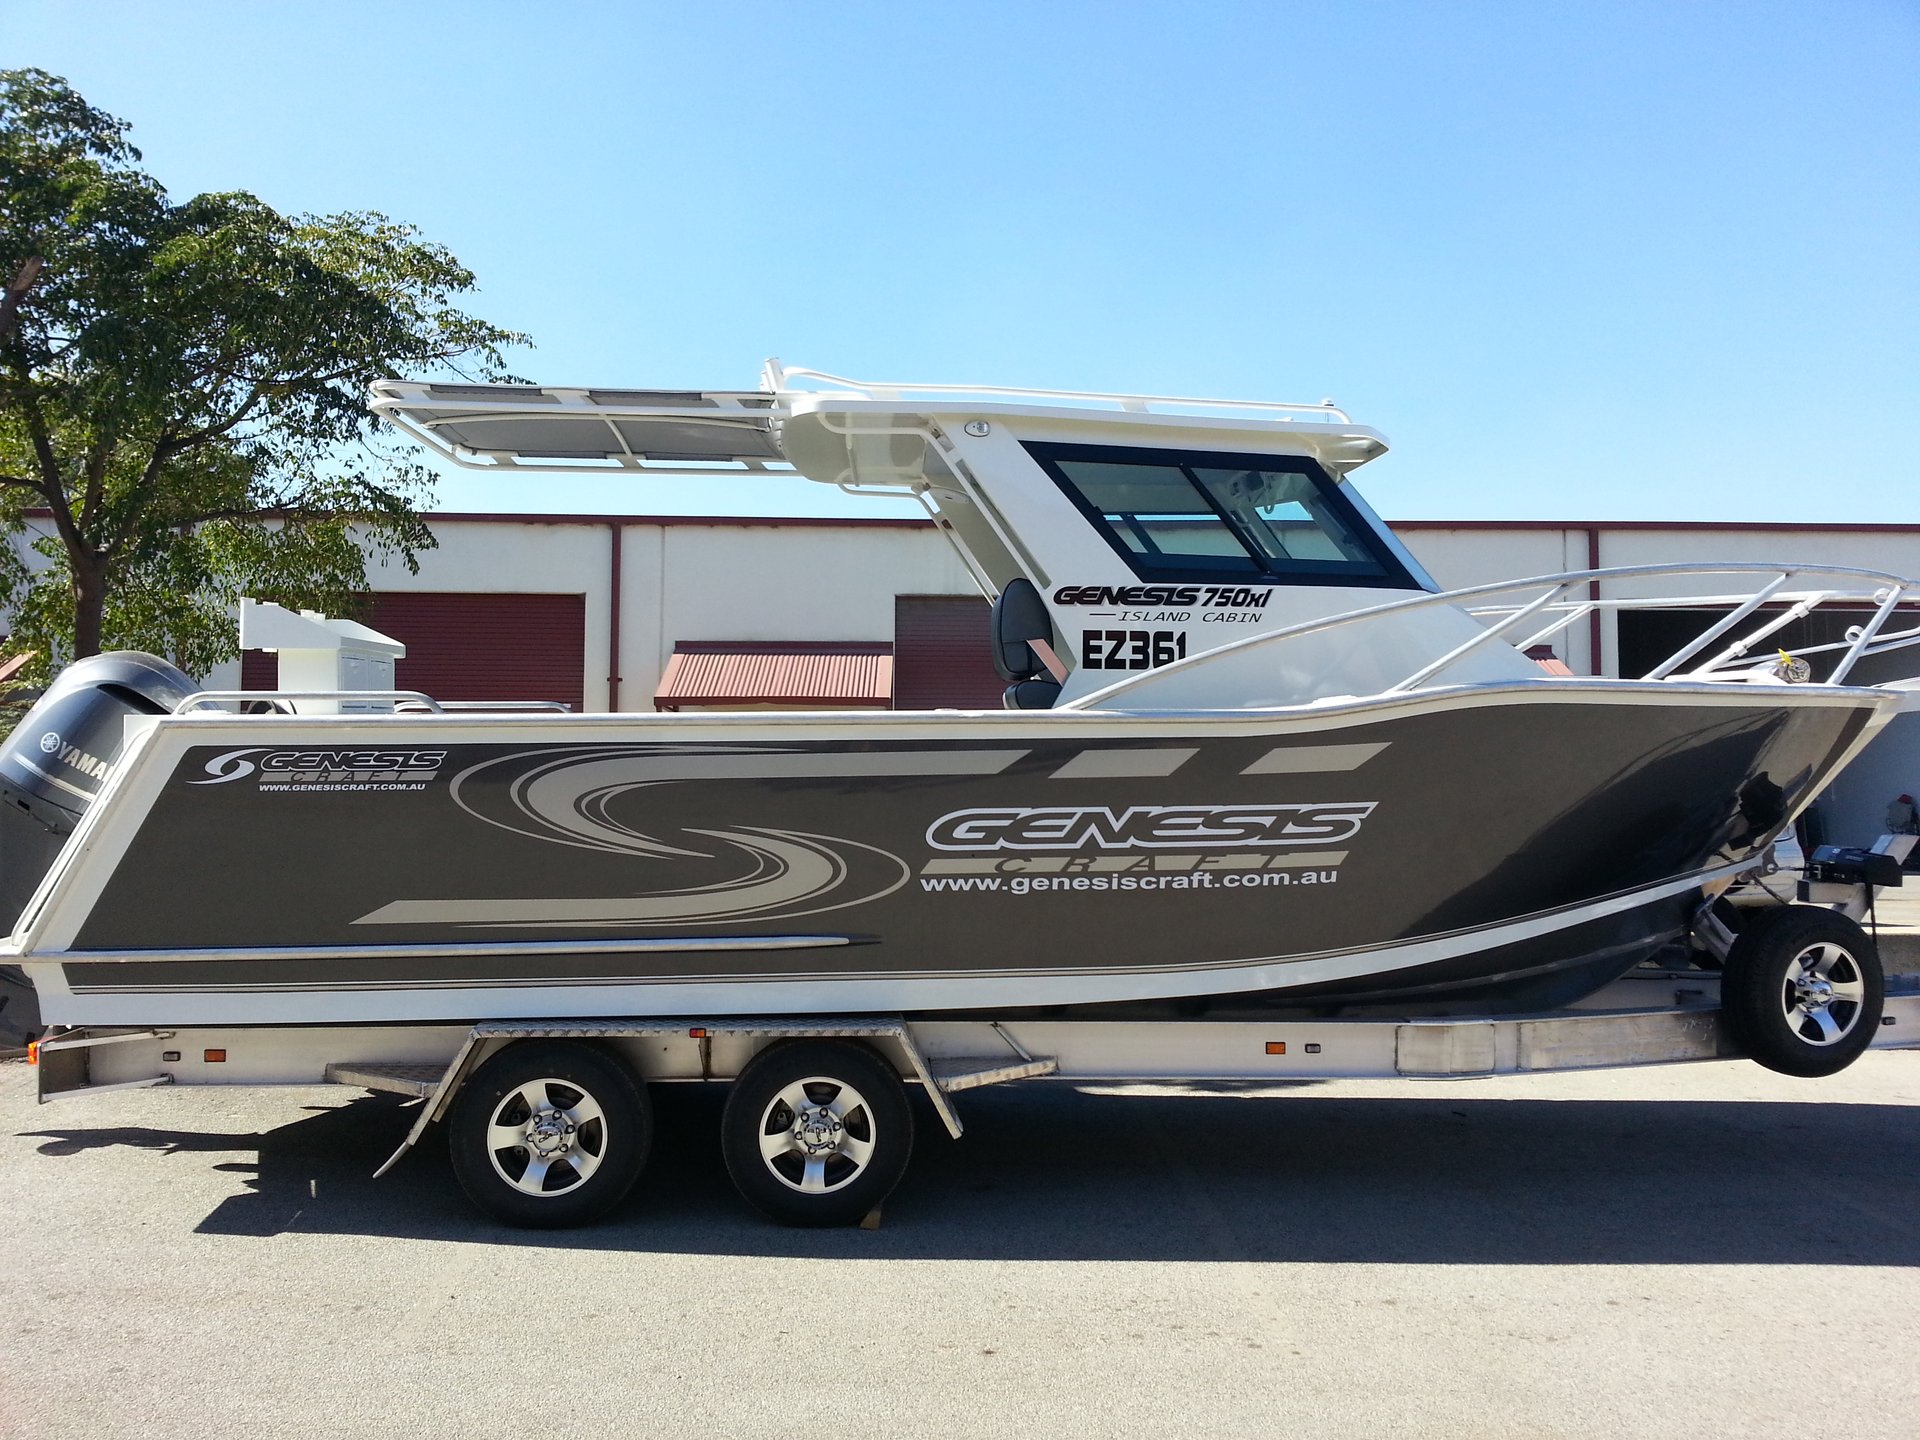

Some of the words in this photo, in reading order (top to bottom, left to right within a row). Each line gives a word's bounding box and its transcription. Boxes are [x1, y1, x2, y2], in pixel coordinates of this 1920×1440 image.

[1053, 585, 1201, 606] GENESIS
[1118, 611, 1191, 622] ISLAND
[1202, 612, 1263, 623] CABIN
[1082, 630, 1186, 669] EZ361
[57, 741, 112, 781] YAMA
[260, 751, 448, 771] GENESIS
[259, 783, 426, 791] WWW.GENESISCRAFT.COM.AU
[290, 771, 411, 782] CRAFT
[925, 801, 1380, 851] GENESIS
[993, 852, 1290, 874] CRAFT
[920, 868, 1338, 895] www.genesiscraft.com.au
